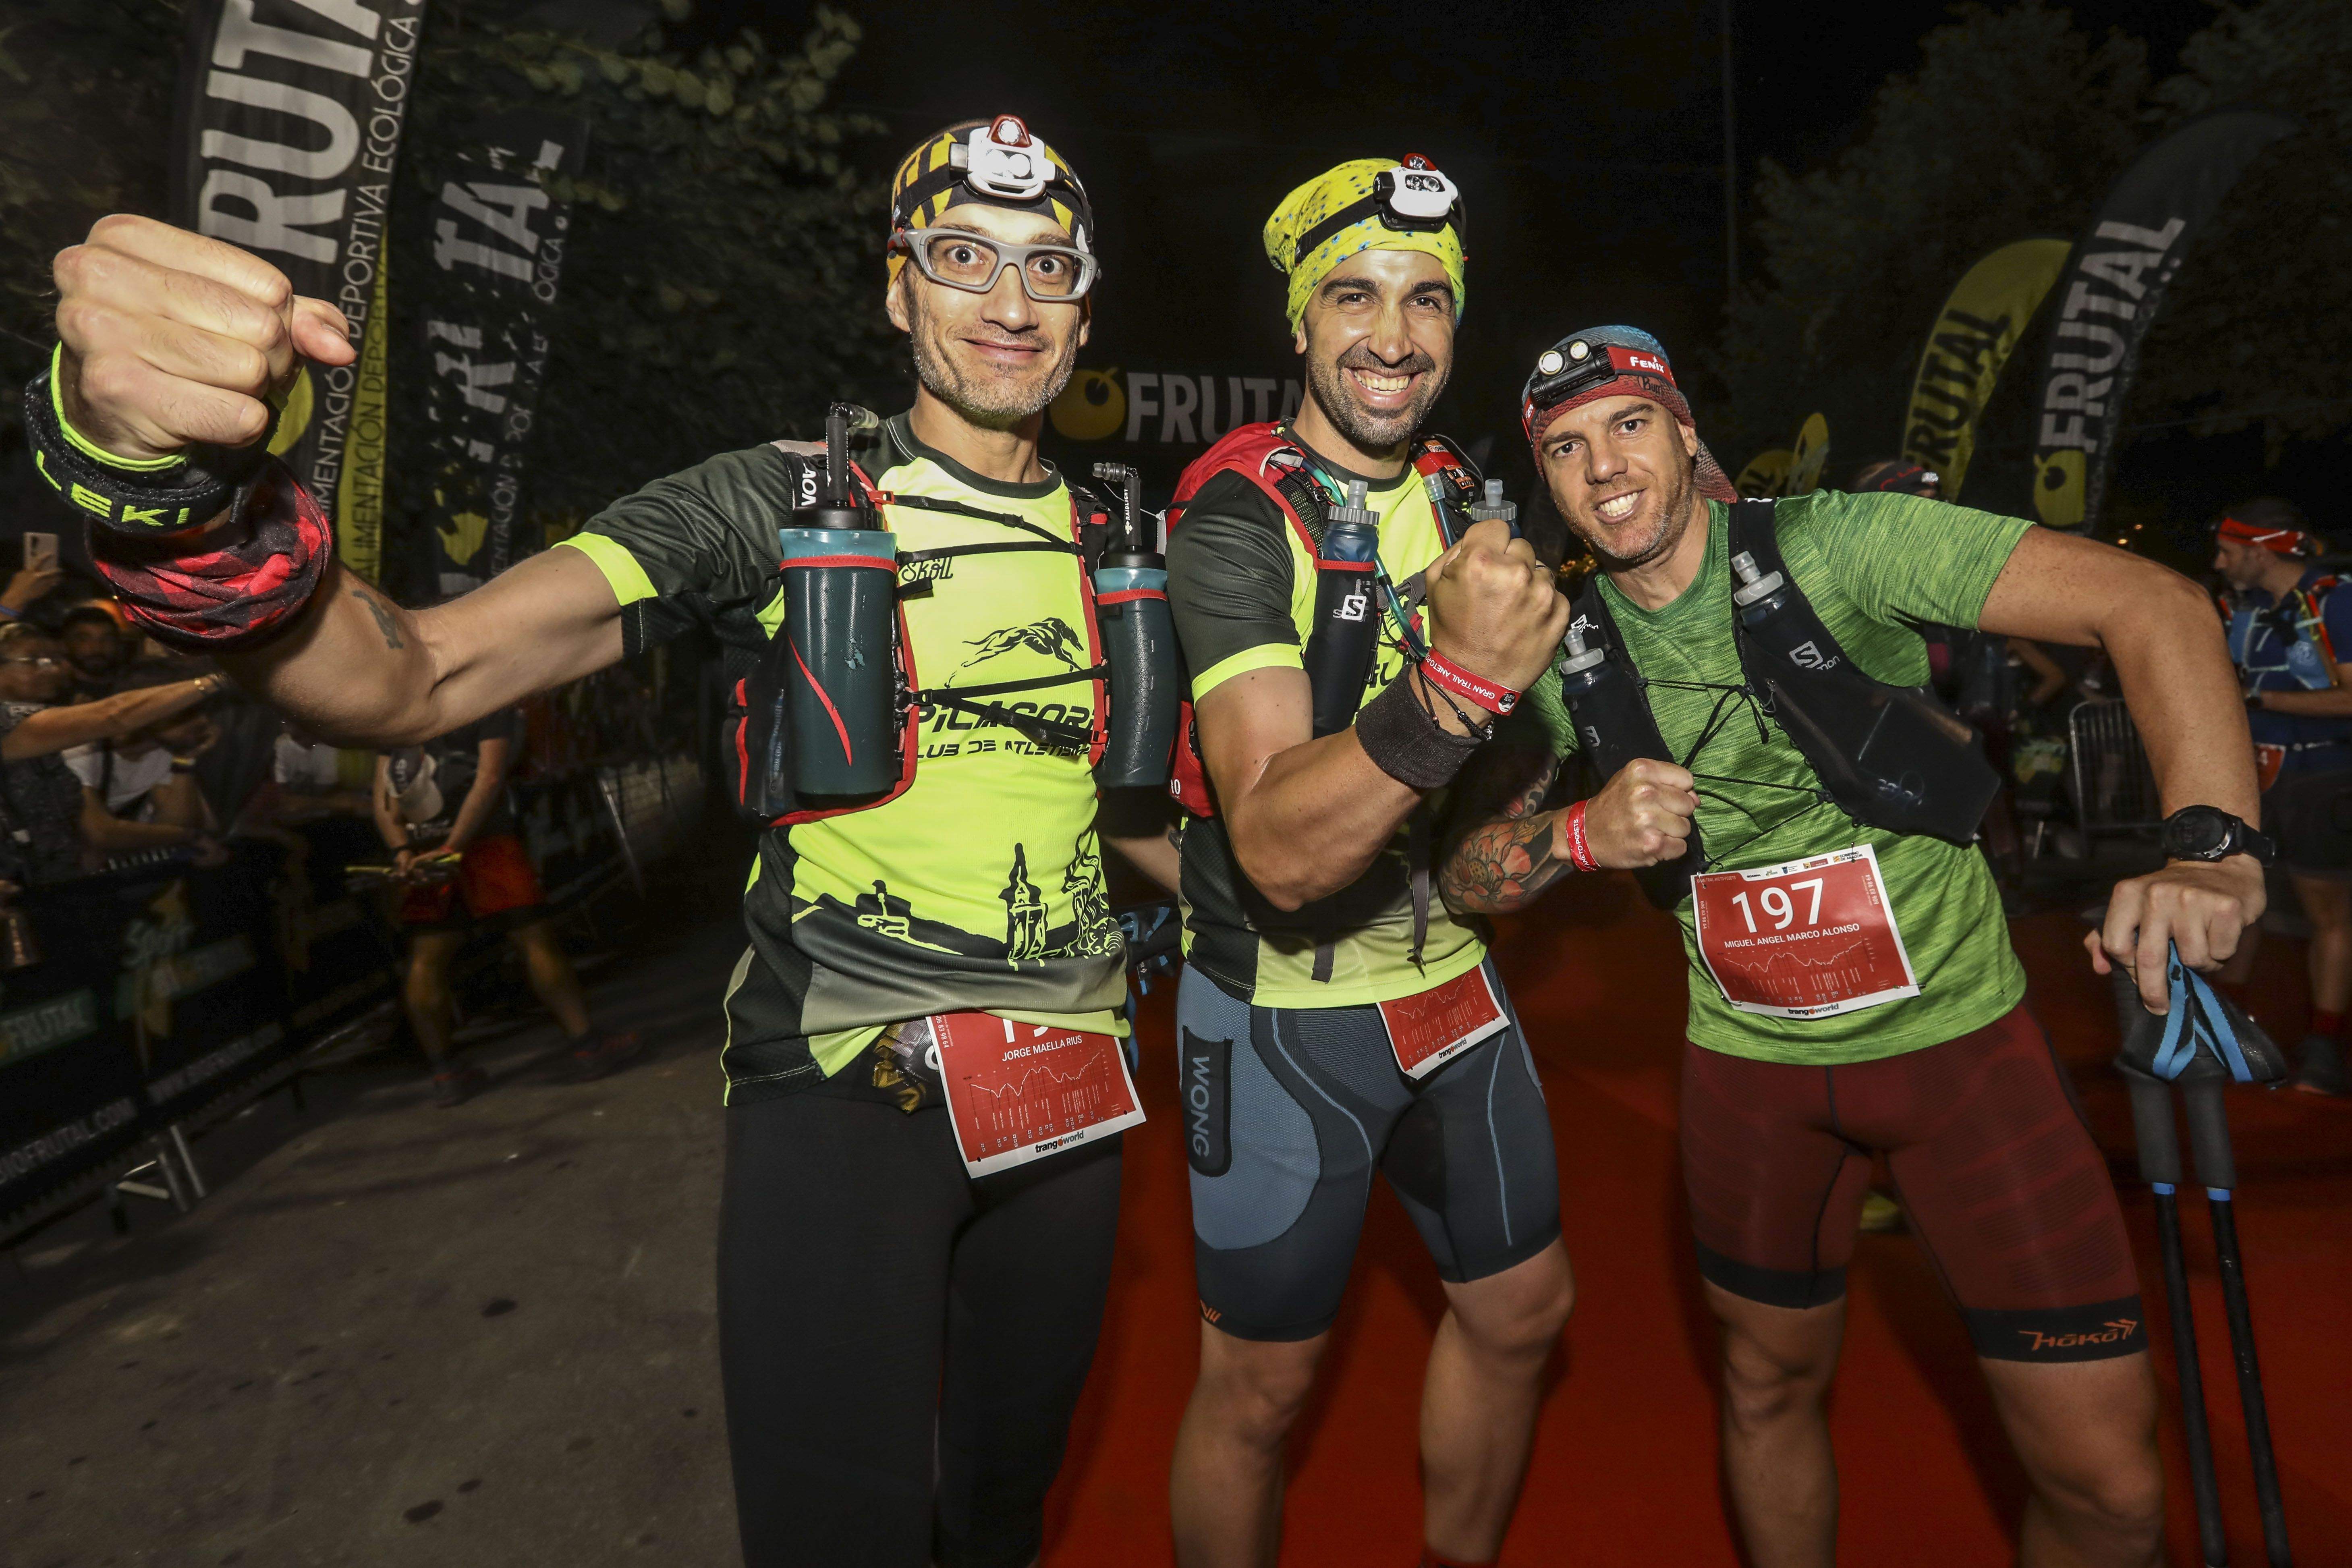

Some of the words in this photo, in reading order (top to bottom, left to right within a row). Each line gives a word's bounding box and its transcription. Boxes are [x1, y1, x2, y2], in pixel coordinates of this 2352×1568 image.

[362, 17, 420, 173] ECOLÓGICA
[2039, 217, 2186, 454] FRUTAL
[1125, 372, 1305, 444] FRUTA
[1905, 309, 2010, 469] RUTAL
[36, 450, 190, 527] LEKI
[1452, 674, 1472, 689] TRAIL
[1472, 684, 1495, 699] GRAN
[967, 740, 996, 755] DE
[1574, 819, 1589, 866] ANETO-POSETS
[1732, 877, 1823, 933] 197
[1724, 940, 1755, 948] MIGUEL
[1757, 935, 1786, 946] ANGEL
[1786, 930, 1820, 942] MARCO
[1822, 923, 1860, 937] ALONSO
[940, 1032, 947, 1040] 98
[1002, 1047, 1032, 1062] JORGE
[1033, 1040, 1065, 1054] MAELLA
[1066, 1035, 1083, 1047] RIUS
[1189, 1056, 1210, 1158] WONG
